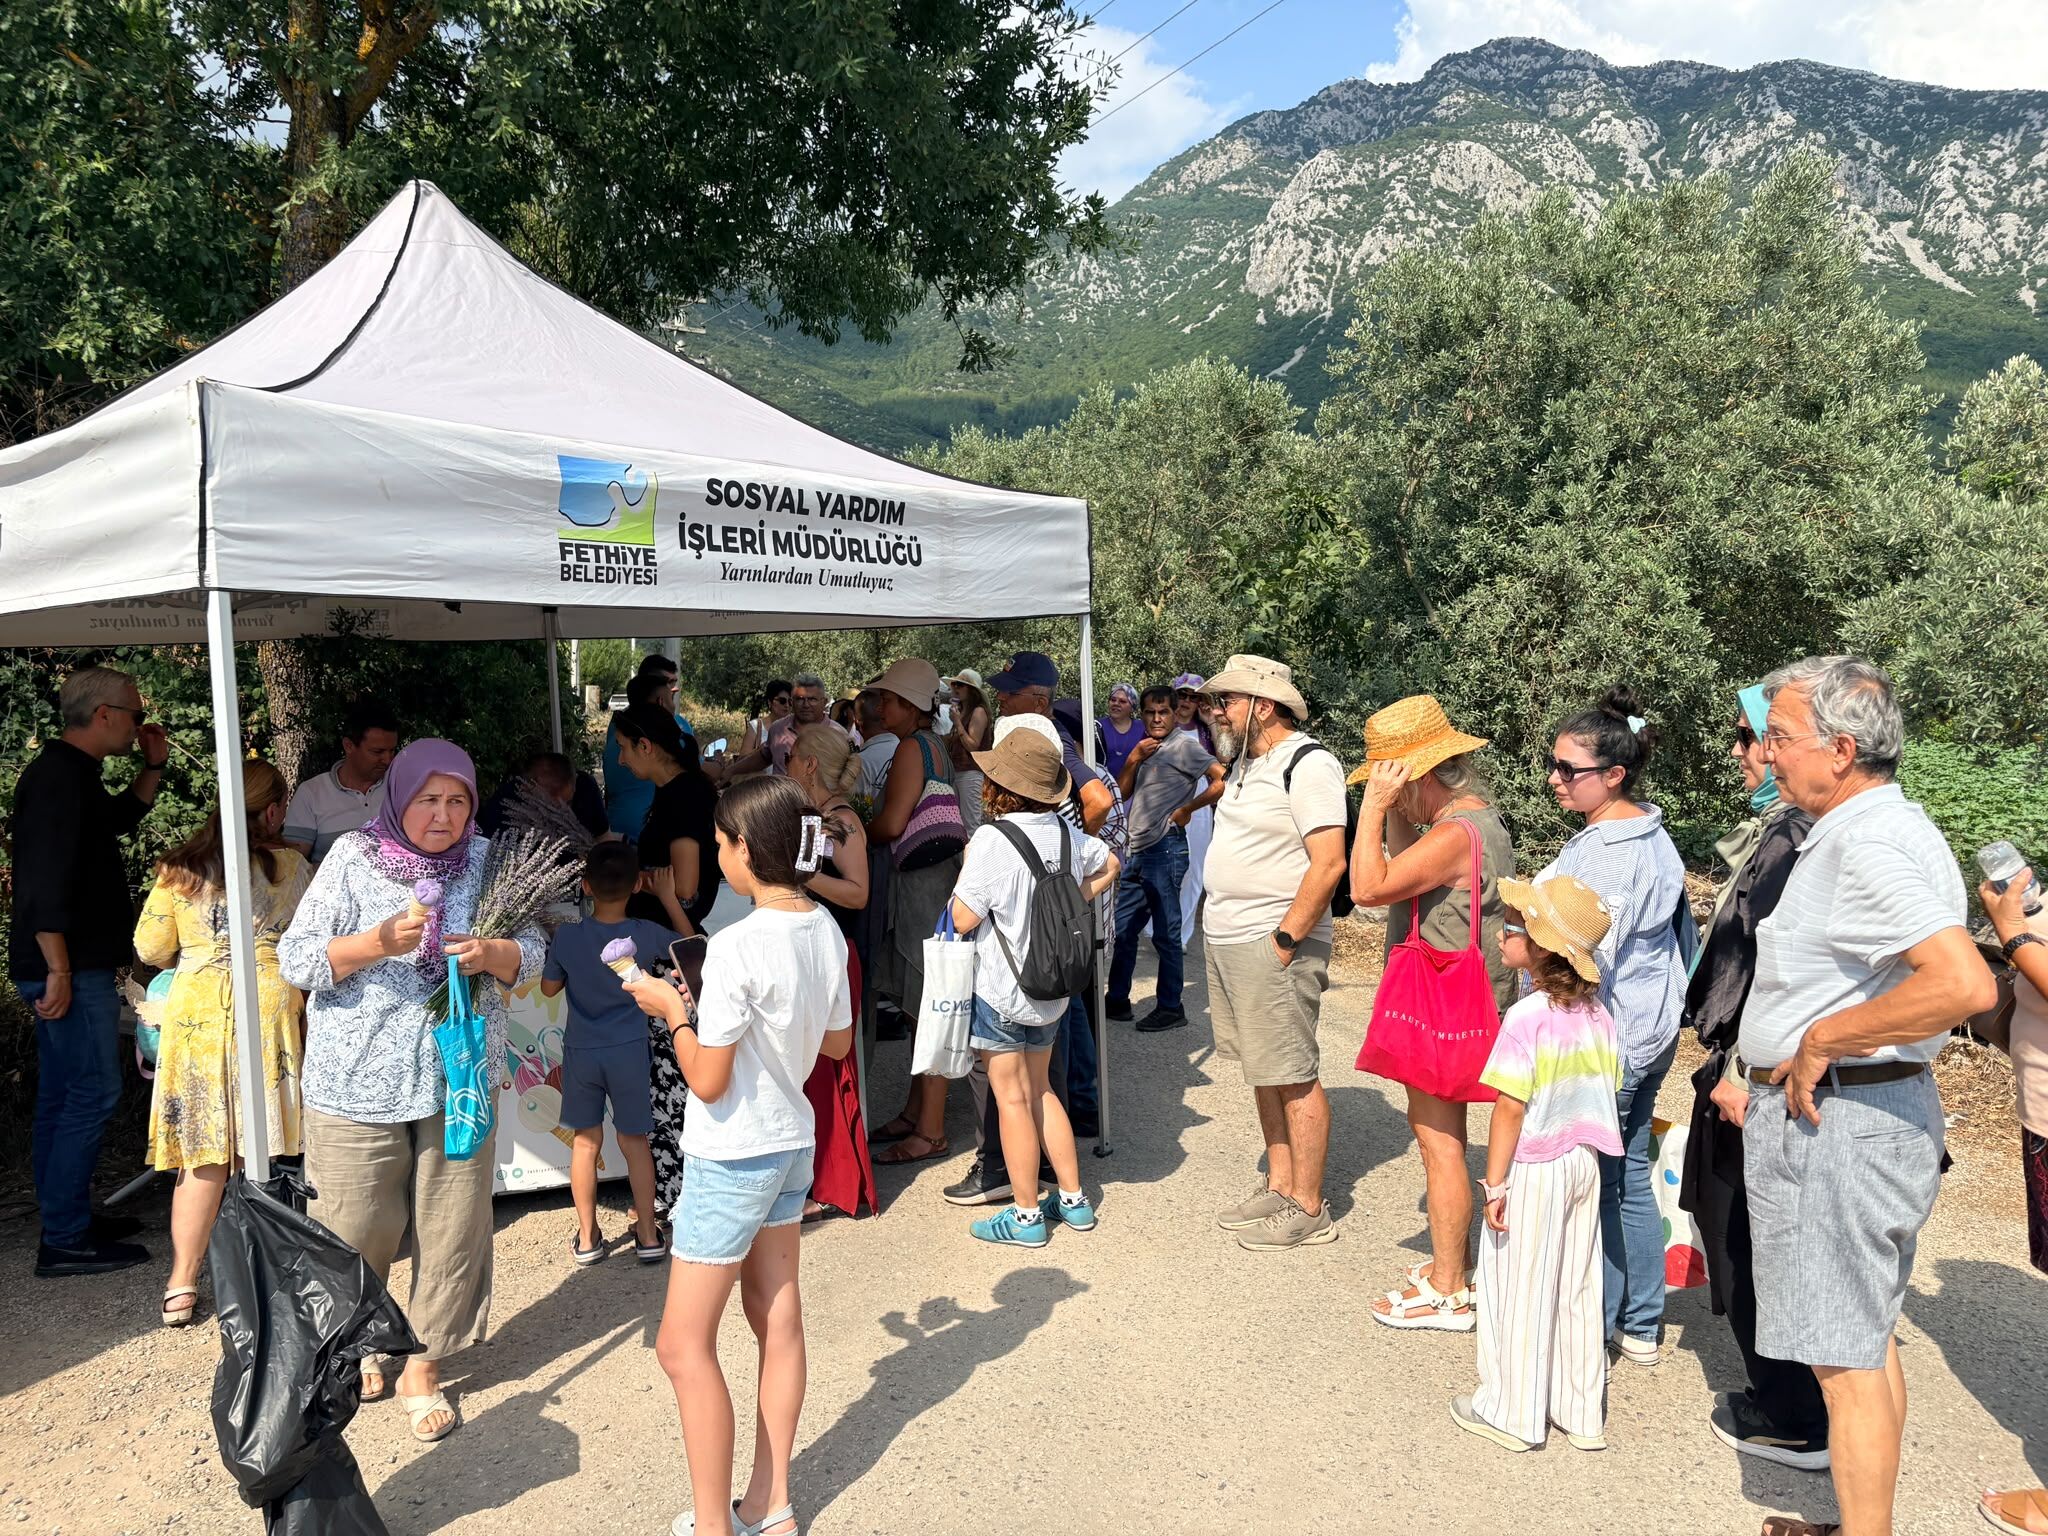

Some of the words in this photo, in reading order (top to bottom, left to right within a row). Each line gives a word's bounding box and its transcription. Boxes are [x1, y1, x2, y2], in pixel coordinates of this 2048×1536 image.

[705, 478, 809, 516] SOSYAL
[816, 490, 906, 526] YARDIM
[678, 512, 767, 559] İŞLERİ
[772, 524, 923, 567] MÜDÜRLÜĞÜ
[720, 562, 813, 585] Yarınlardan
[818, 568, 894, 593] Umutluyuz
[932, 999, 951, 1013] LC
[1384, 1010, 1427, 1031] BEAUTY
